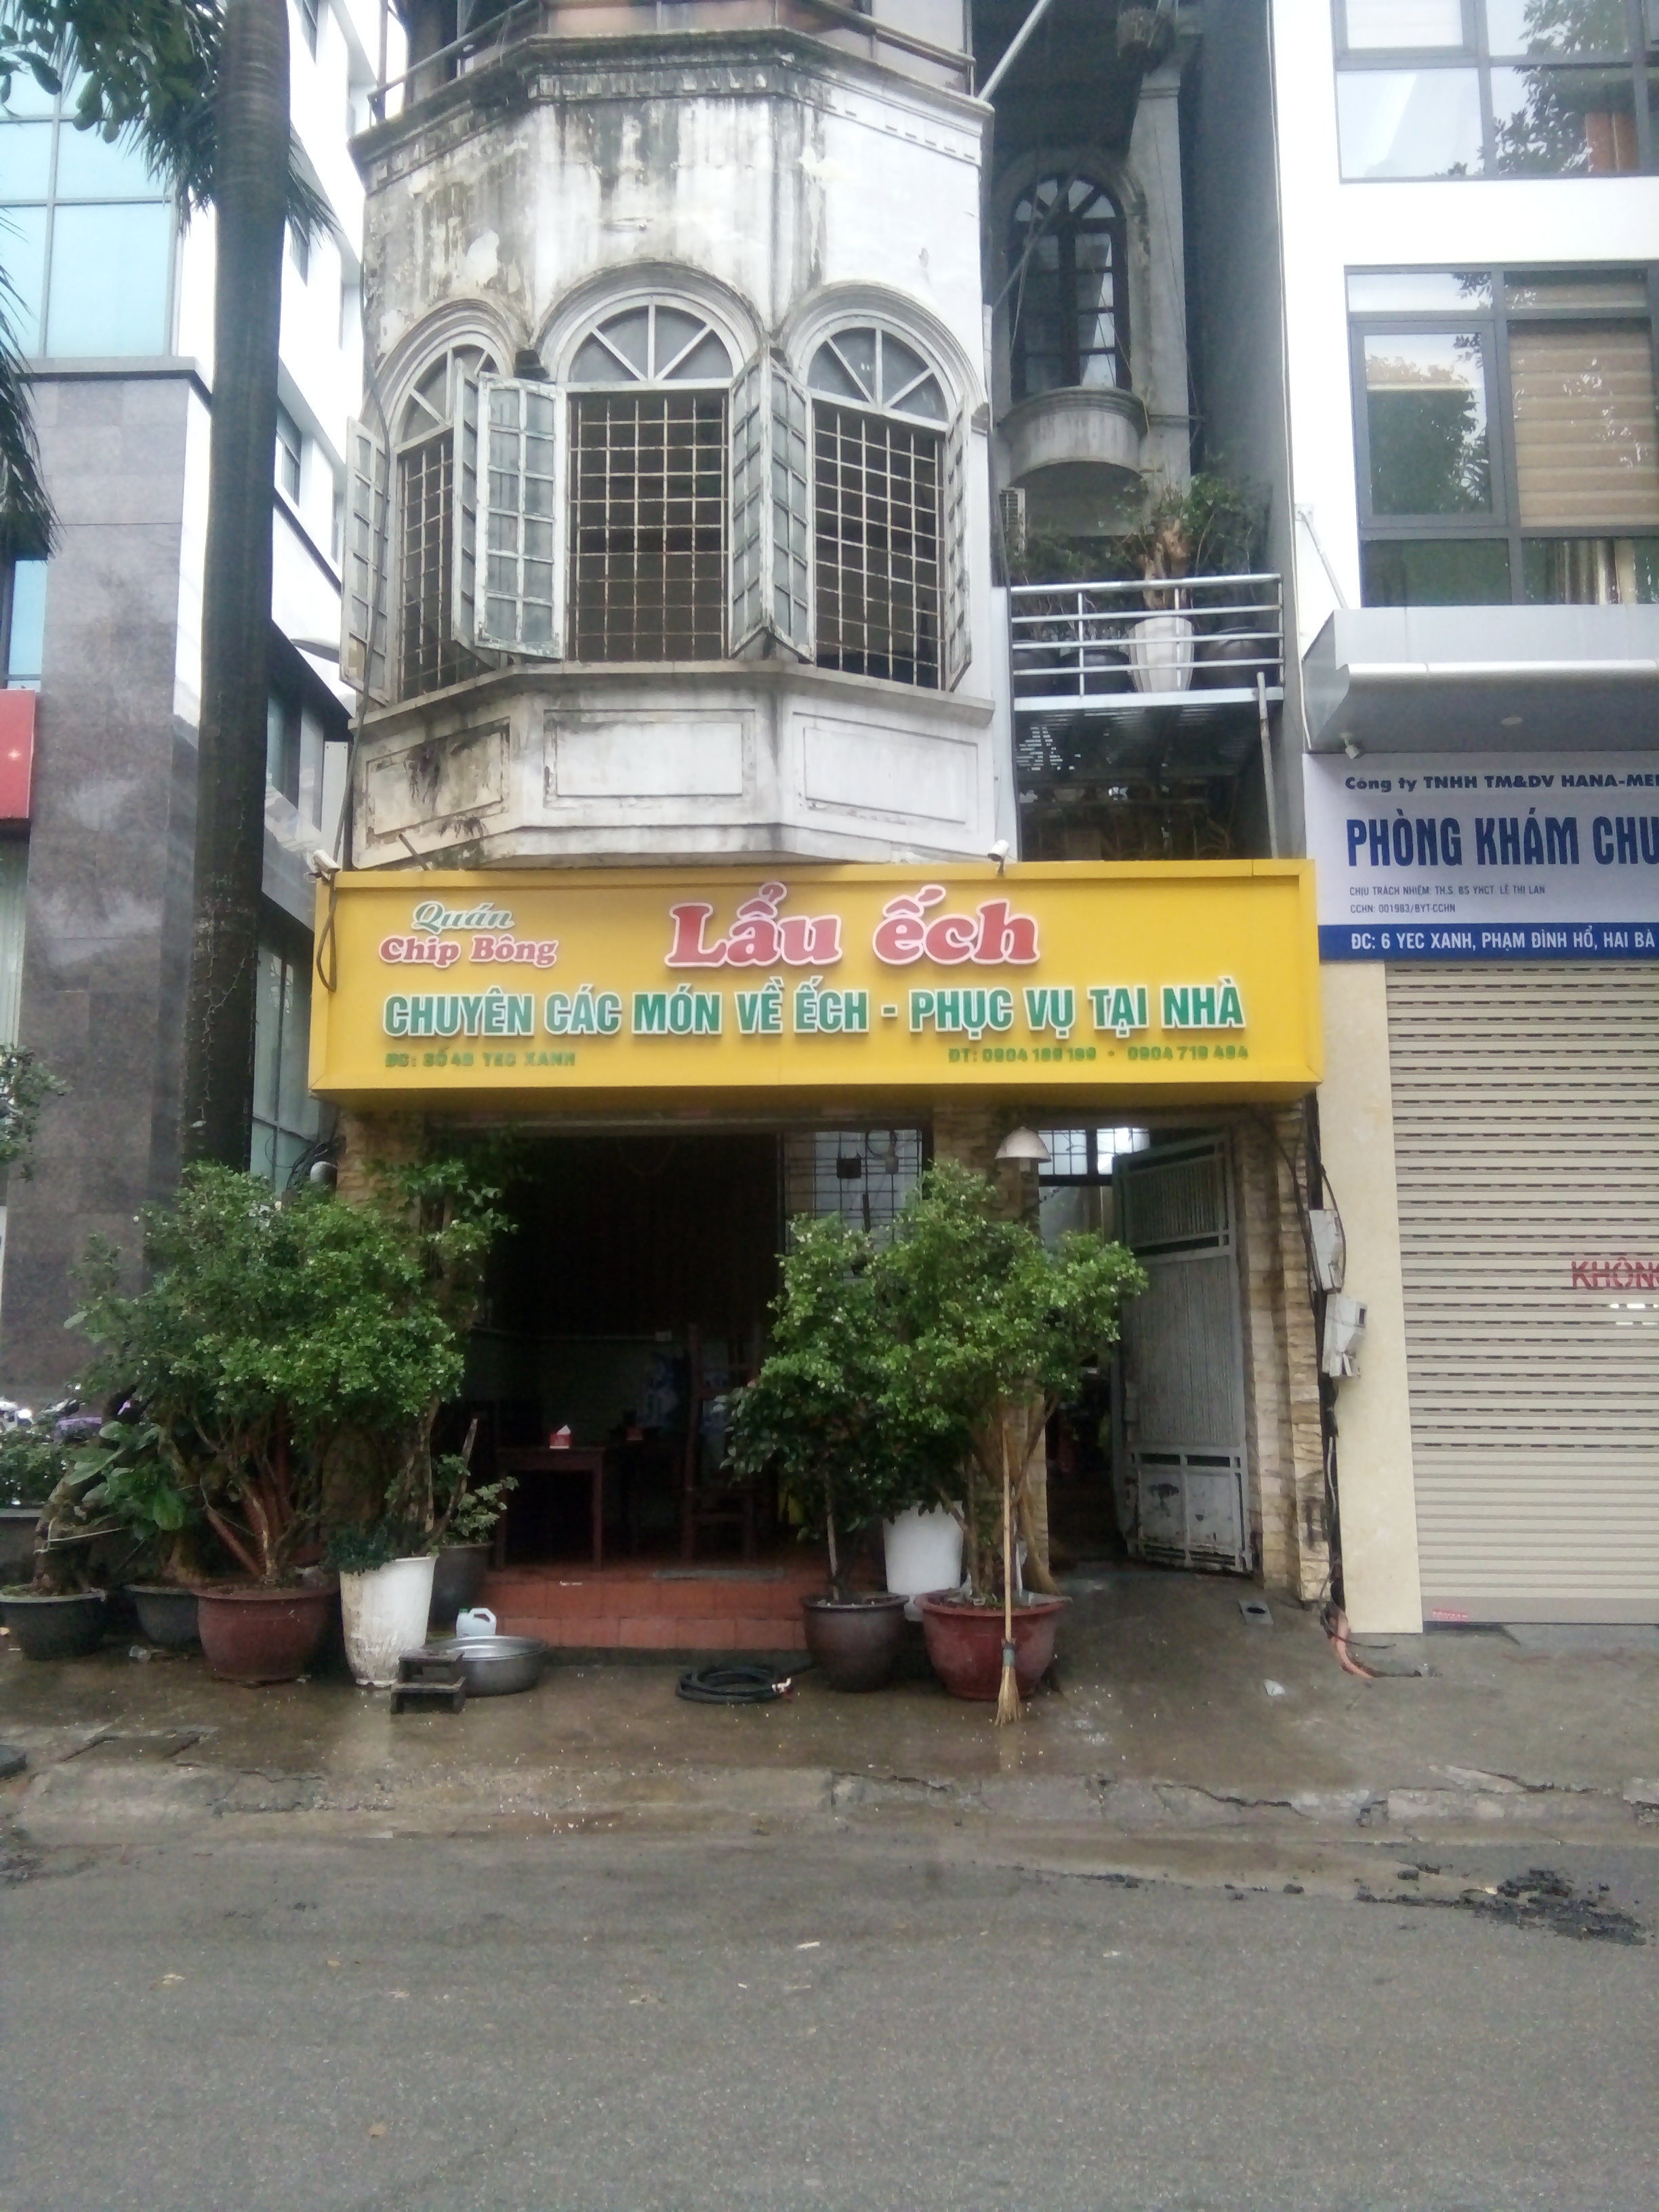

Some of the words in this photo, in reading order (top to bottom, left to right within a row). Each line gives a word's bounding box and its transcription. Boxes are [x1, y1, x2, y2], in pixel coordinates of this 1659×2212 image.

[1398, 777, 1417, 792] ty
[1424, 776, 1478, 788] TNHH
[1484, 775, 1555, 787] TM&DV
[1347, 808, 1462, 867] PHÒNG
[1475, 807, 1580, 865] KHÁM
[1593, 816, 1659, 865] CHU
[1529, 884, 1546, 895] LAN
[411, 901, 515, 935] Quán
[665, 882, 842, 968] Lẩu
[873, 884, 1041, 966] ếch
[1350, 903, 1376, 914] CCHN:
[379, 936, 461, 968] Chip
[469, 935, 558, 968] Bông
[1351, 933, 1376, 949] ĐC:
[1381, 933, 1391, 949] 6
[1396, 933, 1425, 949] YEC
[1431, 933, 1476, 951] XANH,
[1481, 932, 1525, 951] PHẠM
[1531, 928, 1567, 949] ĐÌNH
[1603, 932, 1628, 948] HAI
[1635, 929, 1655, 948] BÀ
[384, 985, 535, 1038] CHUYÊN
[544, 984, 622, 1036] CÁC
[632, 983, 722, 1036] MÓN
[735, 977, 783, 1034] VỀ
[794, 976, 869, 1033] ẾCH
[909, 987, 1015, 1040] PHỤC
[1023, 986, 1076, 1040] VỤ
[1087, 985, 1150, 1038] TẠI
[1161, 976, 1246, 1029] NHÀ
[1572, 1256, 1659, 1290] KHÔN
